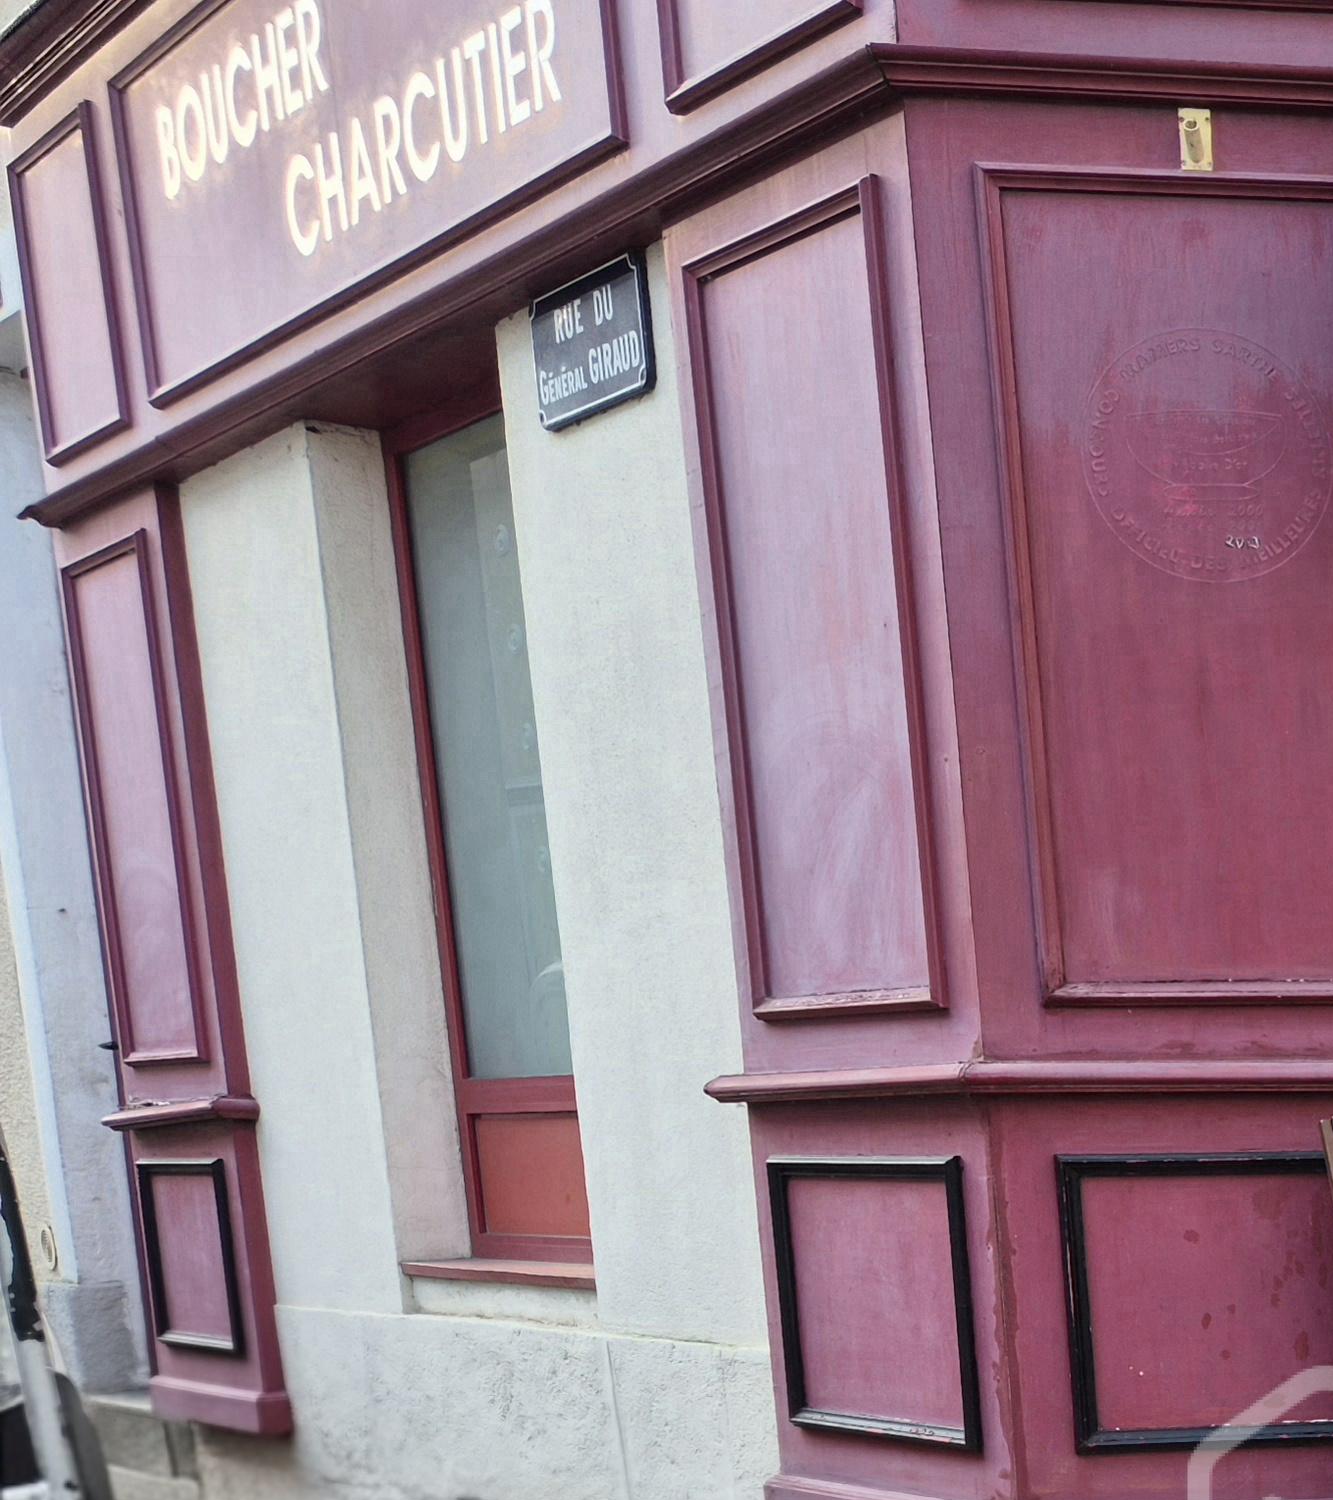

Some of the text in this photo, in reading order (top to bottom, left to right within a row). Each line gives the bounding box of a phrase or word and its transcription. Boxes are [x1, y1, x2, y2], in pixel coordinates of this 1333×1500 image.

[155, 0, 329, 200] BOUCHER
[286, 0, 562, 256] CHARCUTIER
[539, 330, 641, 406] GÉNÉRAL GIRAUD
[553, 284, 614, 345] RUE DU
